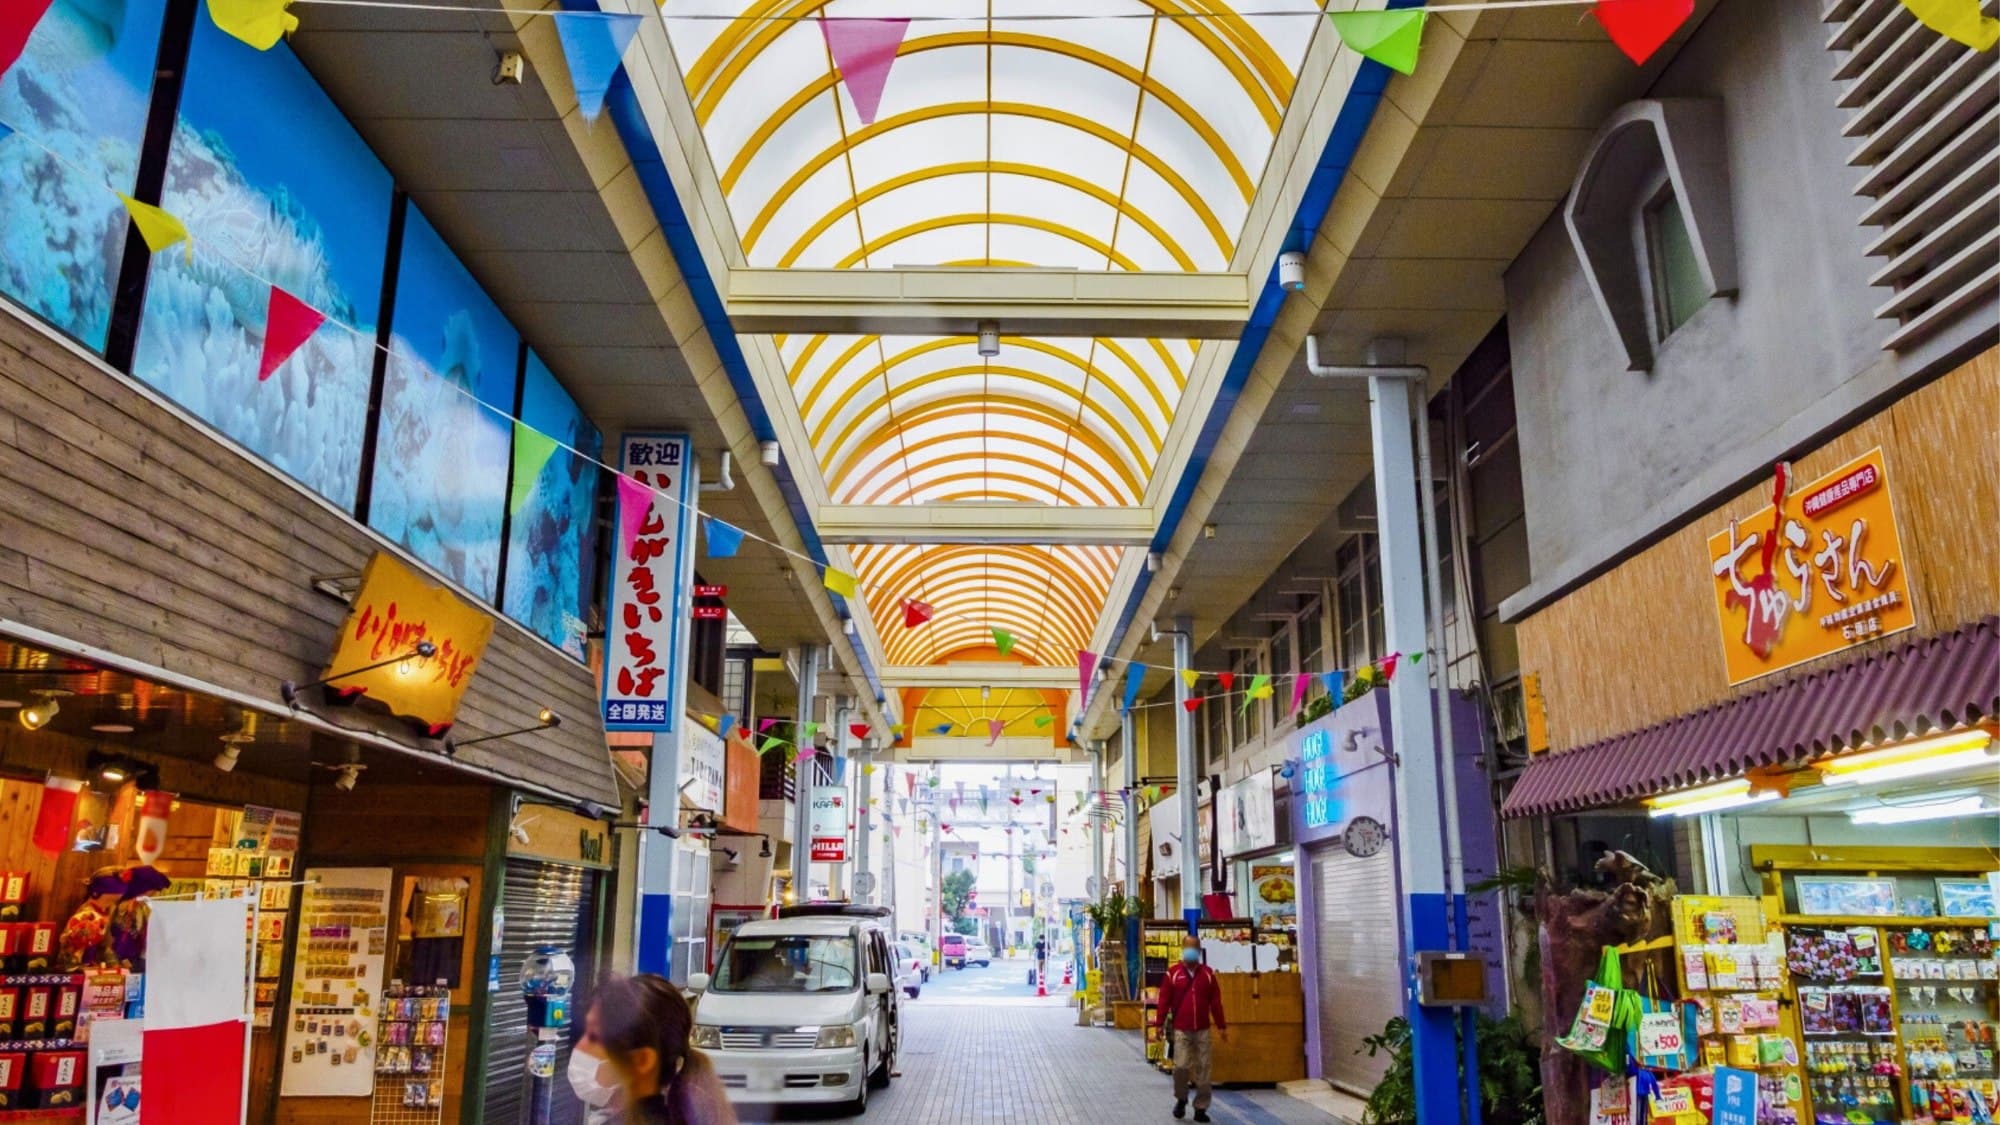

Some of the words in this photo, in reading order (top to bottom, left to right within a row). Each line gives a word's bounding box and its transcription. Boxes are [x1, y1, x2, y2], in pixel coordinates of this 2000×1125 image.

[629, 442, 680, 466] 歓迎
[1713, 518, 1895, 645] ちゅらさん
[607, 702, 666, 721] 全国発送
